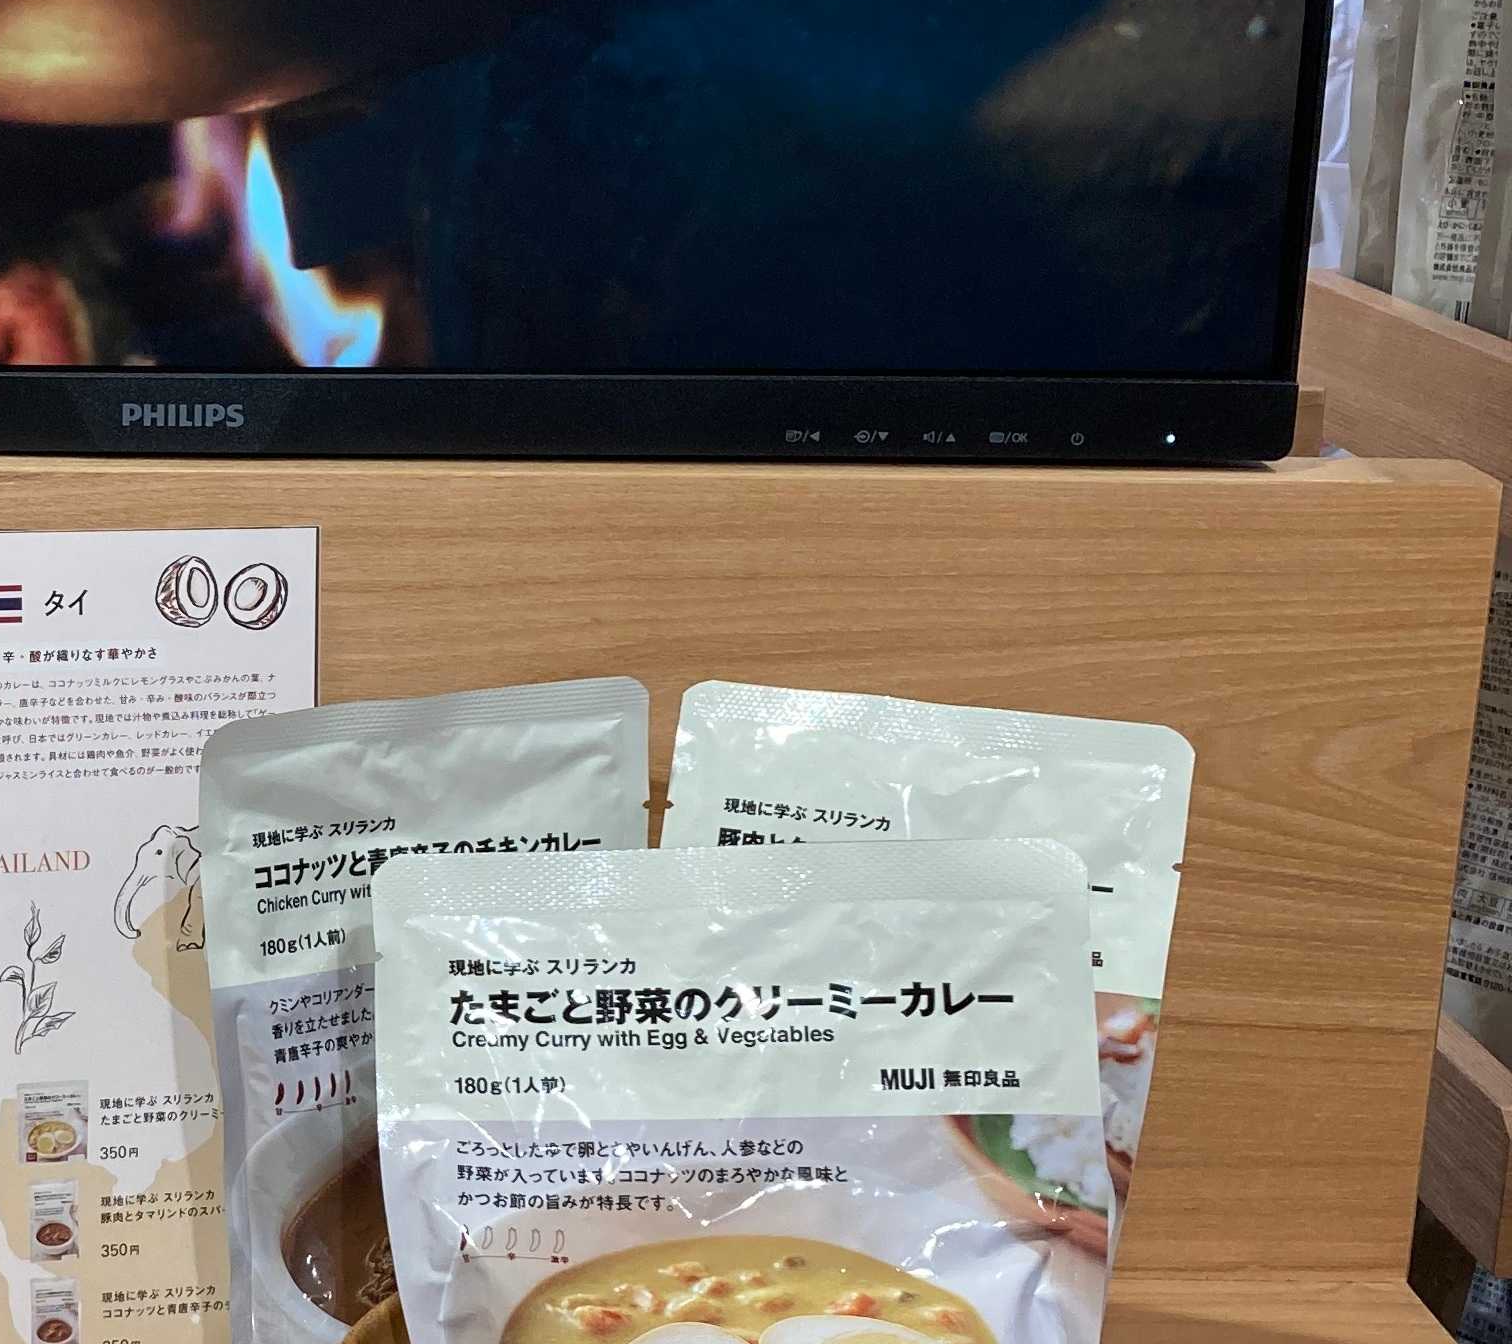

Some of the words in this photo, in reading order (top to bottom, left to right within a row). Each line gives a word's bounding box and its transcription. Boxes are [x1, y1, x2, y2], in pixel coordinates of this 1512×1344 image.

[121, 403, 245, 428] PHILIPS
[44, 589, 88, 616] タイ
[723, 797, 808, 821] 現地に学ぶ
[813, 808, 891, 832] スリランカ
[252, 825, 323, 849] 現地に学ぶ
[328, 816, 396, 838] スリランカ
[257, 893, 308, 915] Chicken
[312, 888, 347, 908] Curry
[260, 927, 346, 957] 180g(1人前)
[448, 959, 539, 977] 現地に学ぶ
[547, 958, 636, 976] スリランカ
[269, 983, 375, 1015] クミンやコリアンダー
[450, 981, 1015, 1026] たまごと野菜のクリーミーカレー
[535, 1031, 591, 1051] Curry
[597, 1030, 641, 1047] with
[647, 1029, 687, 1050] Egg
[694, 1028, 709, 1046] &
[880, 1068, 936, 1091] MUJI
[943, 1069, 1021, 1088] 無印良品
[99, 1096, 157, 1110] 現地に学ぶ
[162, 1093, 214, 1106] スリランカ
[99, 1145, 139, 1160] 350円
[100, 1193, 158, 1207] 現地に学ぶ
[163, 1190, 215, 1203] スリランカ
[457, 1192, 674, 1212] かつお節の旨みが特長です。
[101, 1243, 140, 1258] 350円
[101, 1289, 159, 1303] 現地に学ぶ
[164, 1285, 216, 1299] スリランカ
